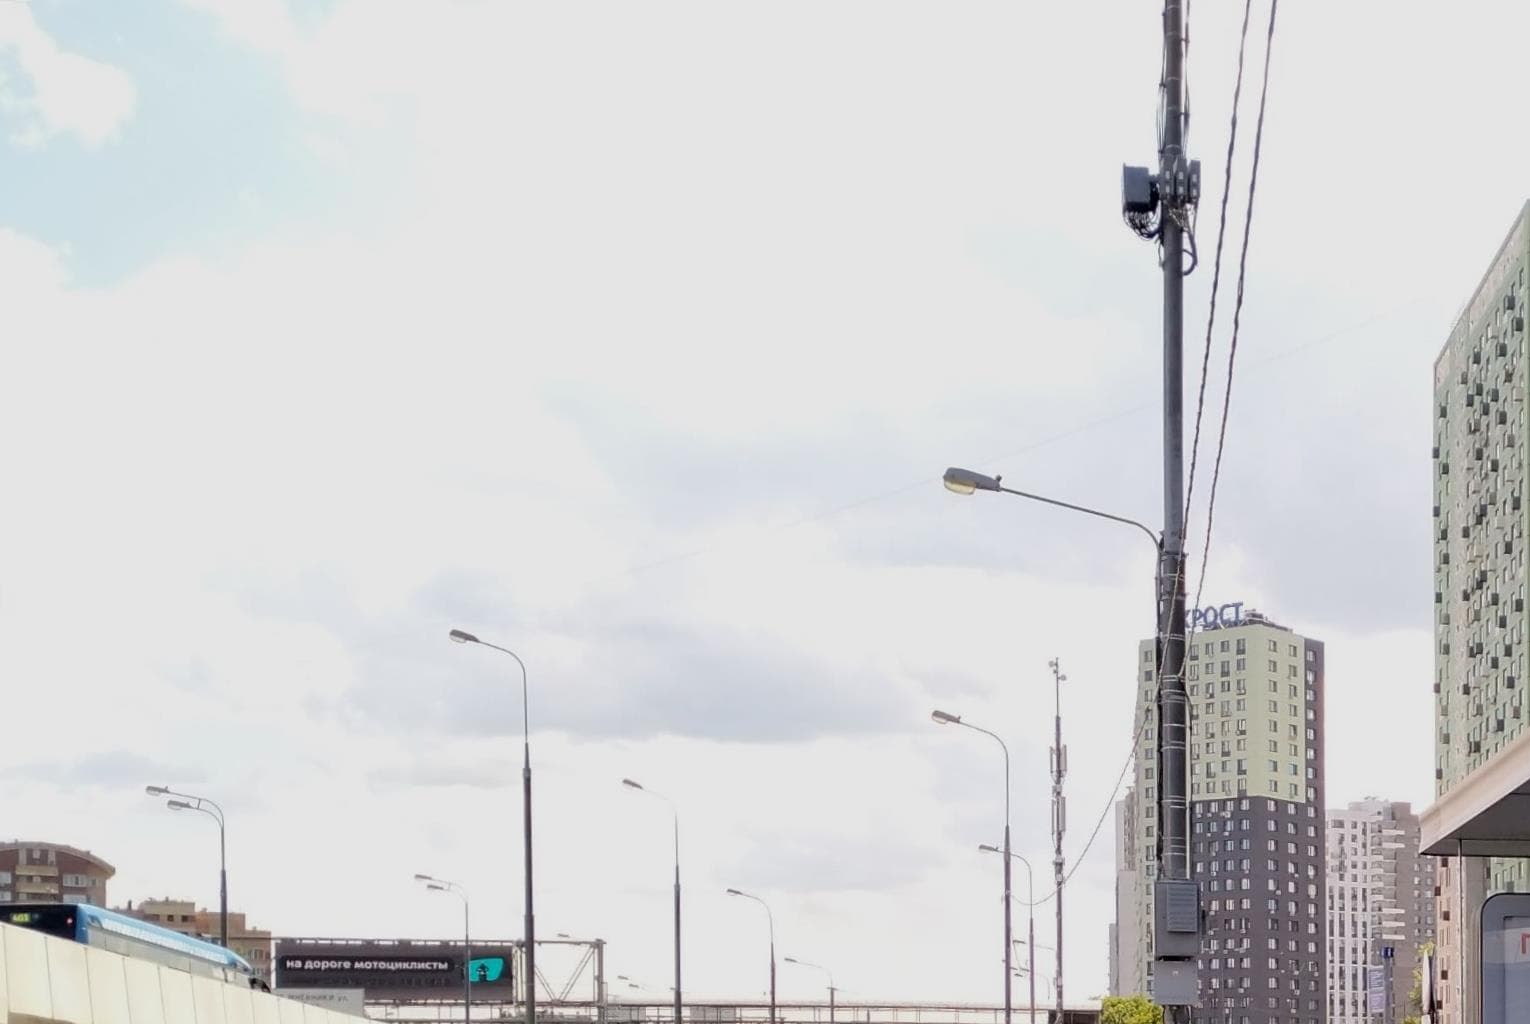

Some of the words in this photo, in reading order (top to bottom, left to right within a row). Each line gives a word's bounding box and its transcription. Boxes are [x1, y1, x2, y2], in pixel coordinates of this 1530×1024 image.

[286, 959, 302, 969] на
[304, 959, 350, 971] дороге
[354, 960, 448, 971] мотоциклисты
